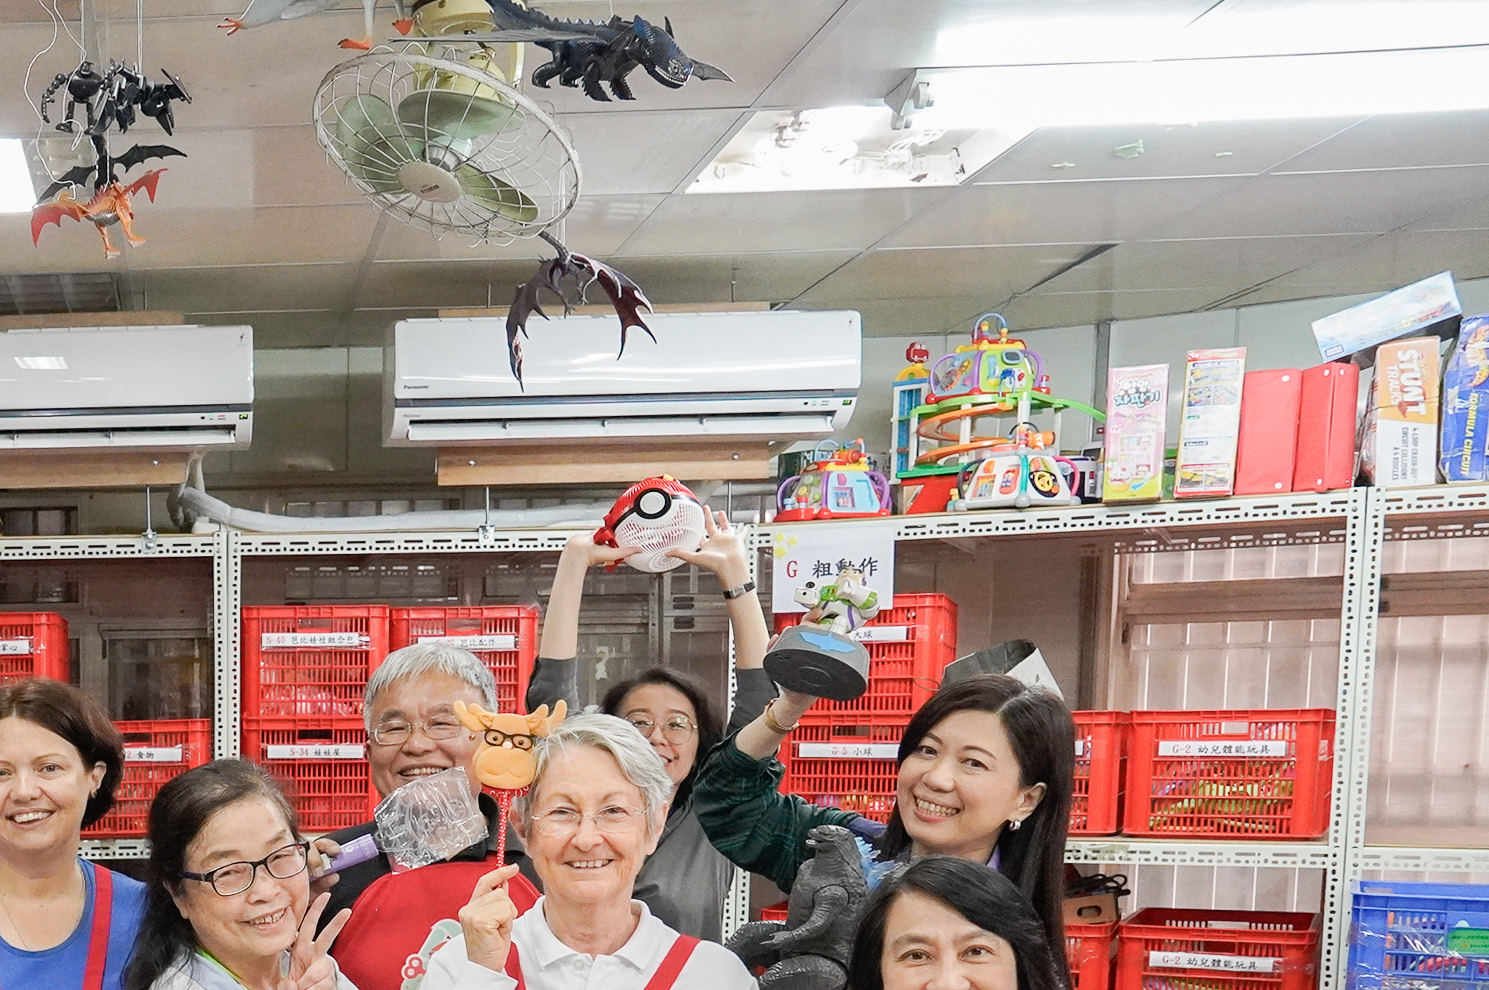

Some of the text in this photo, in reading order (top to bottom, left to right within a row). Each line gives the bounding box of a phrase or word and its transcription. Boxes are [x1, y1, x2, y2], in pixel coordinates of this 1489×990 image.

[1385, 364, 1404, 407] TRACKS
[1396, 348, 1428, 416] STUNT
[1401, 427, 1409, 448] CIRCUIT
[1459, 392, 1479, 477] FORMULA CIRCUIT
[786, 560, 798, 578] G
[266, 634, 286, 645] S-40
[136, 750, 155, 760] 食物
[289, 747, 310, 757] S-34
[853, 746, 873, 757] 小球
[1171, 743, 1272, 756] G-2 幼兒體能玩具
[1161, 954, 1259, 971] G-2 幼兒體能玩具
